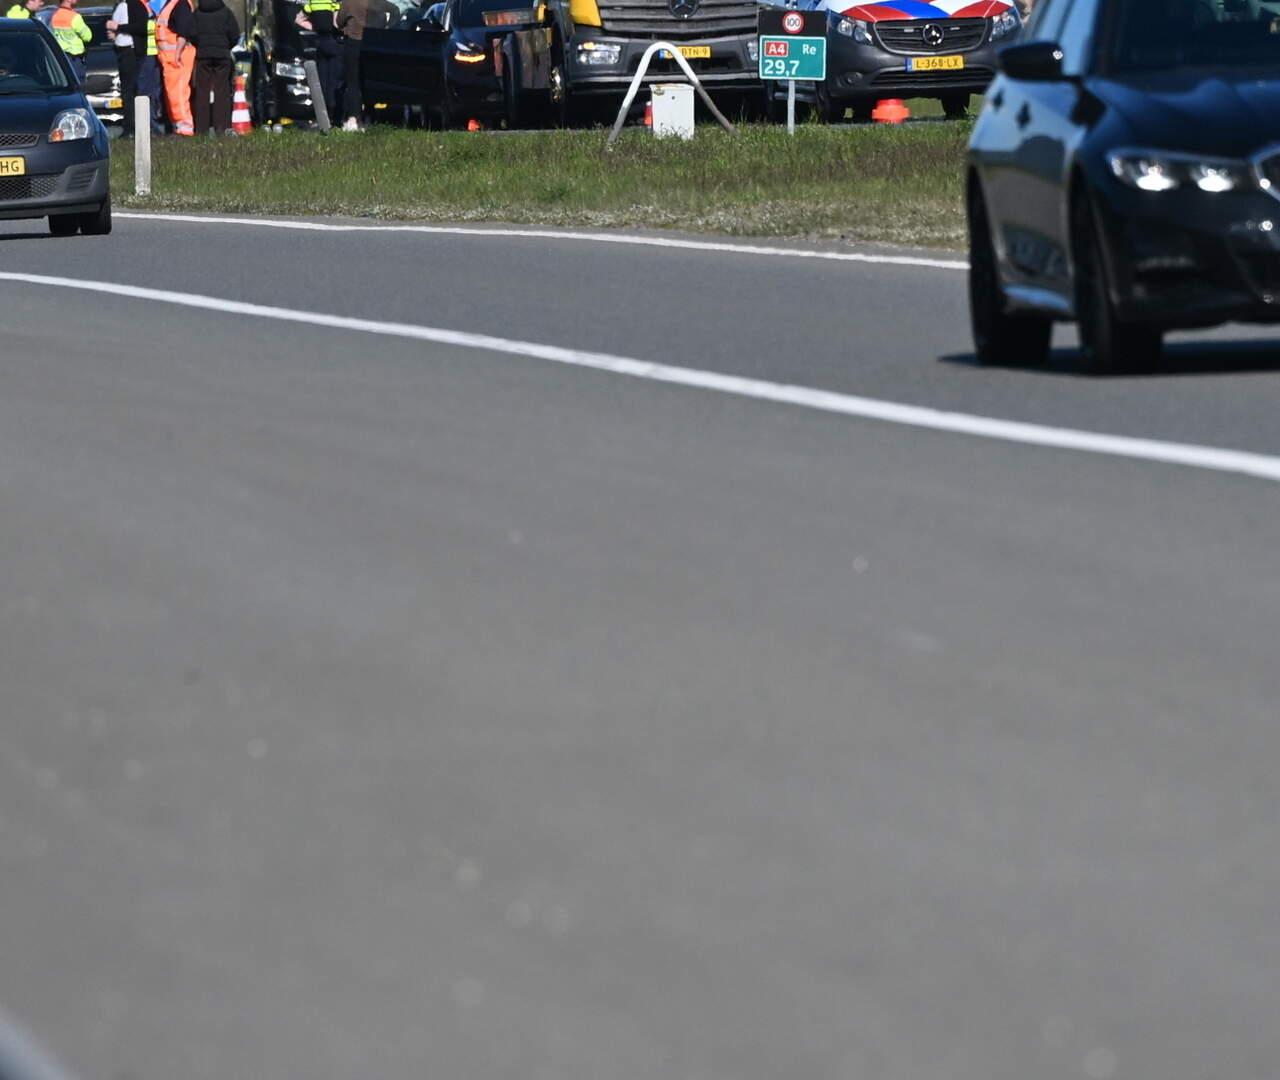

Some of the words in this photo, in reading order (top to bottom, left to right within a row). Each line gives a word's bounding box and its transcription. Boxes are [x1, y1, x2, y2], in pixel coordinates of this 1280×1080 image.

[768, 43, 785, 55] A4
[802, 43, 817, 55] Re
[764, 59, 800, 77] 29,7
[916, 57, 959, 69] L-368-LX
